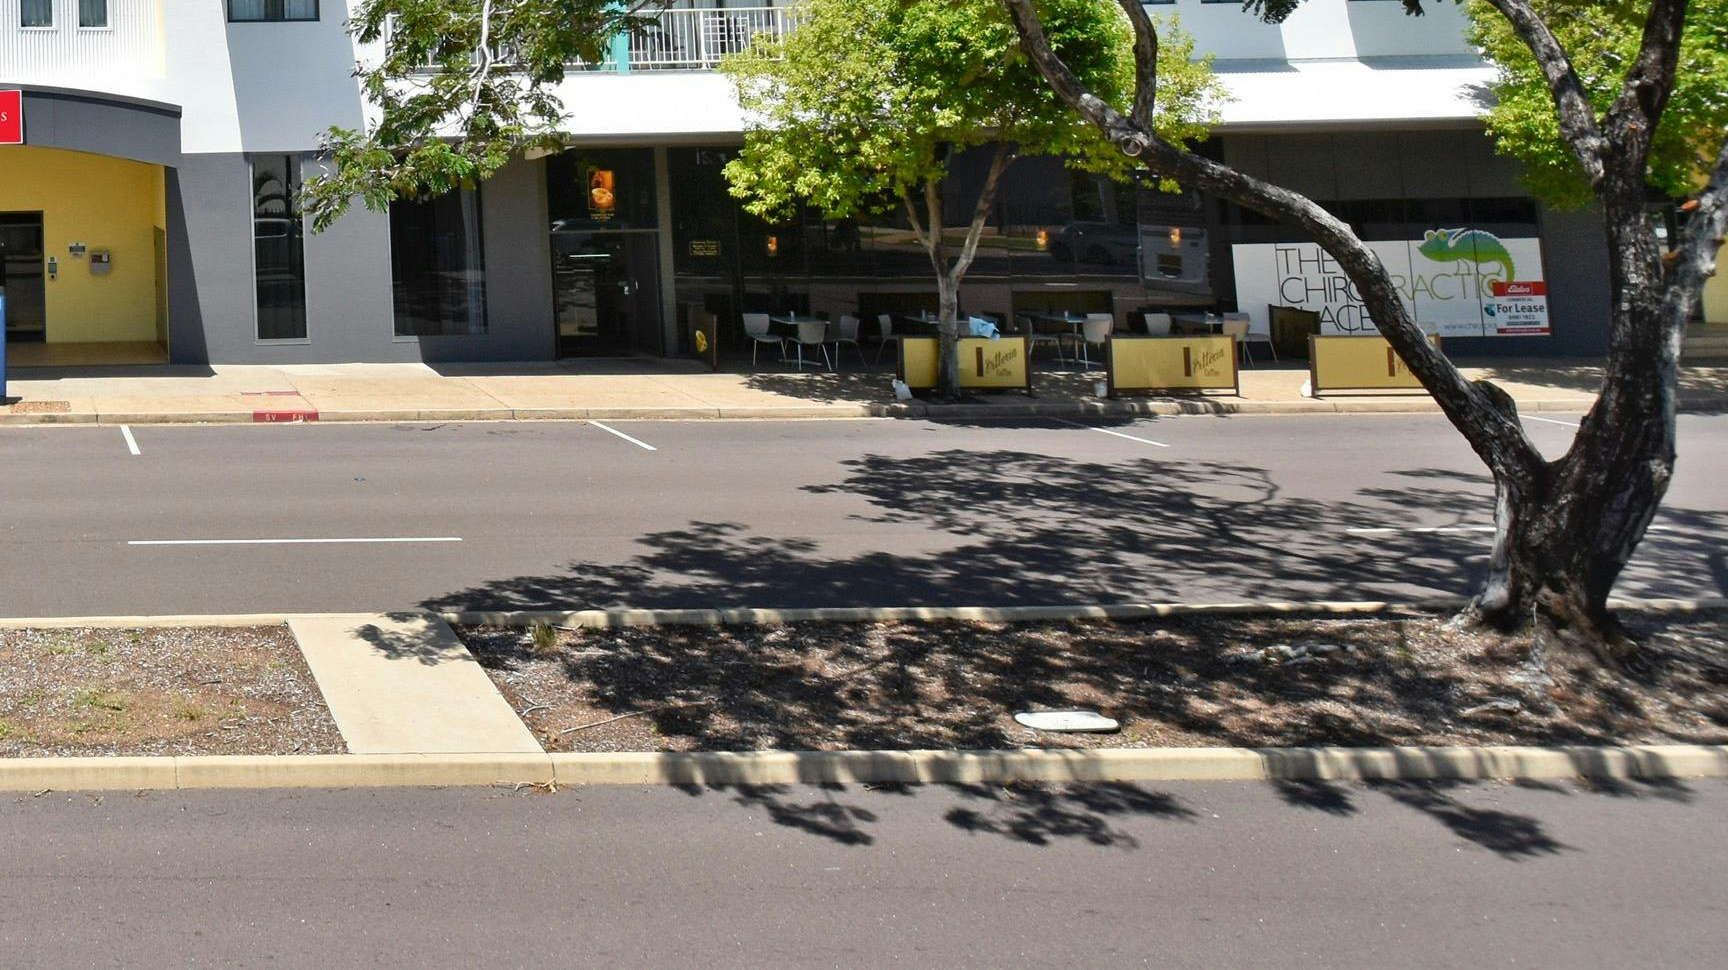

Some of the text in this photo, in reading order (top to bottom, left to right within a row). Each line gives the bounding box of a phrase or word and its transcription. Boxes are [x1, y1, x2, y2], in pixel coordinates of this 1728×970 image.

[1276, 247, 1337, 275] THE
[1496, 303, 1545, 313] For Lease
